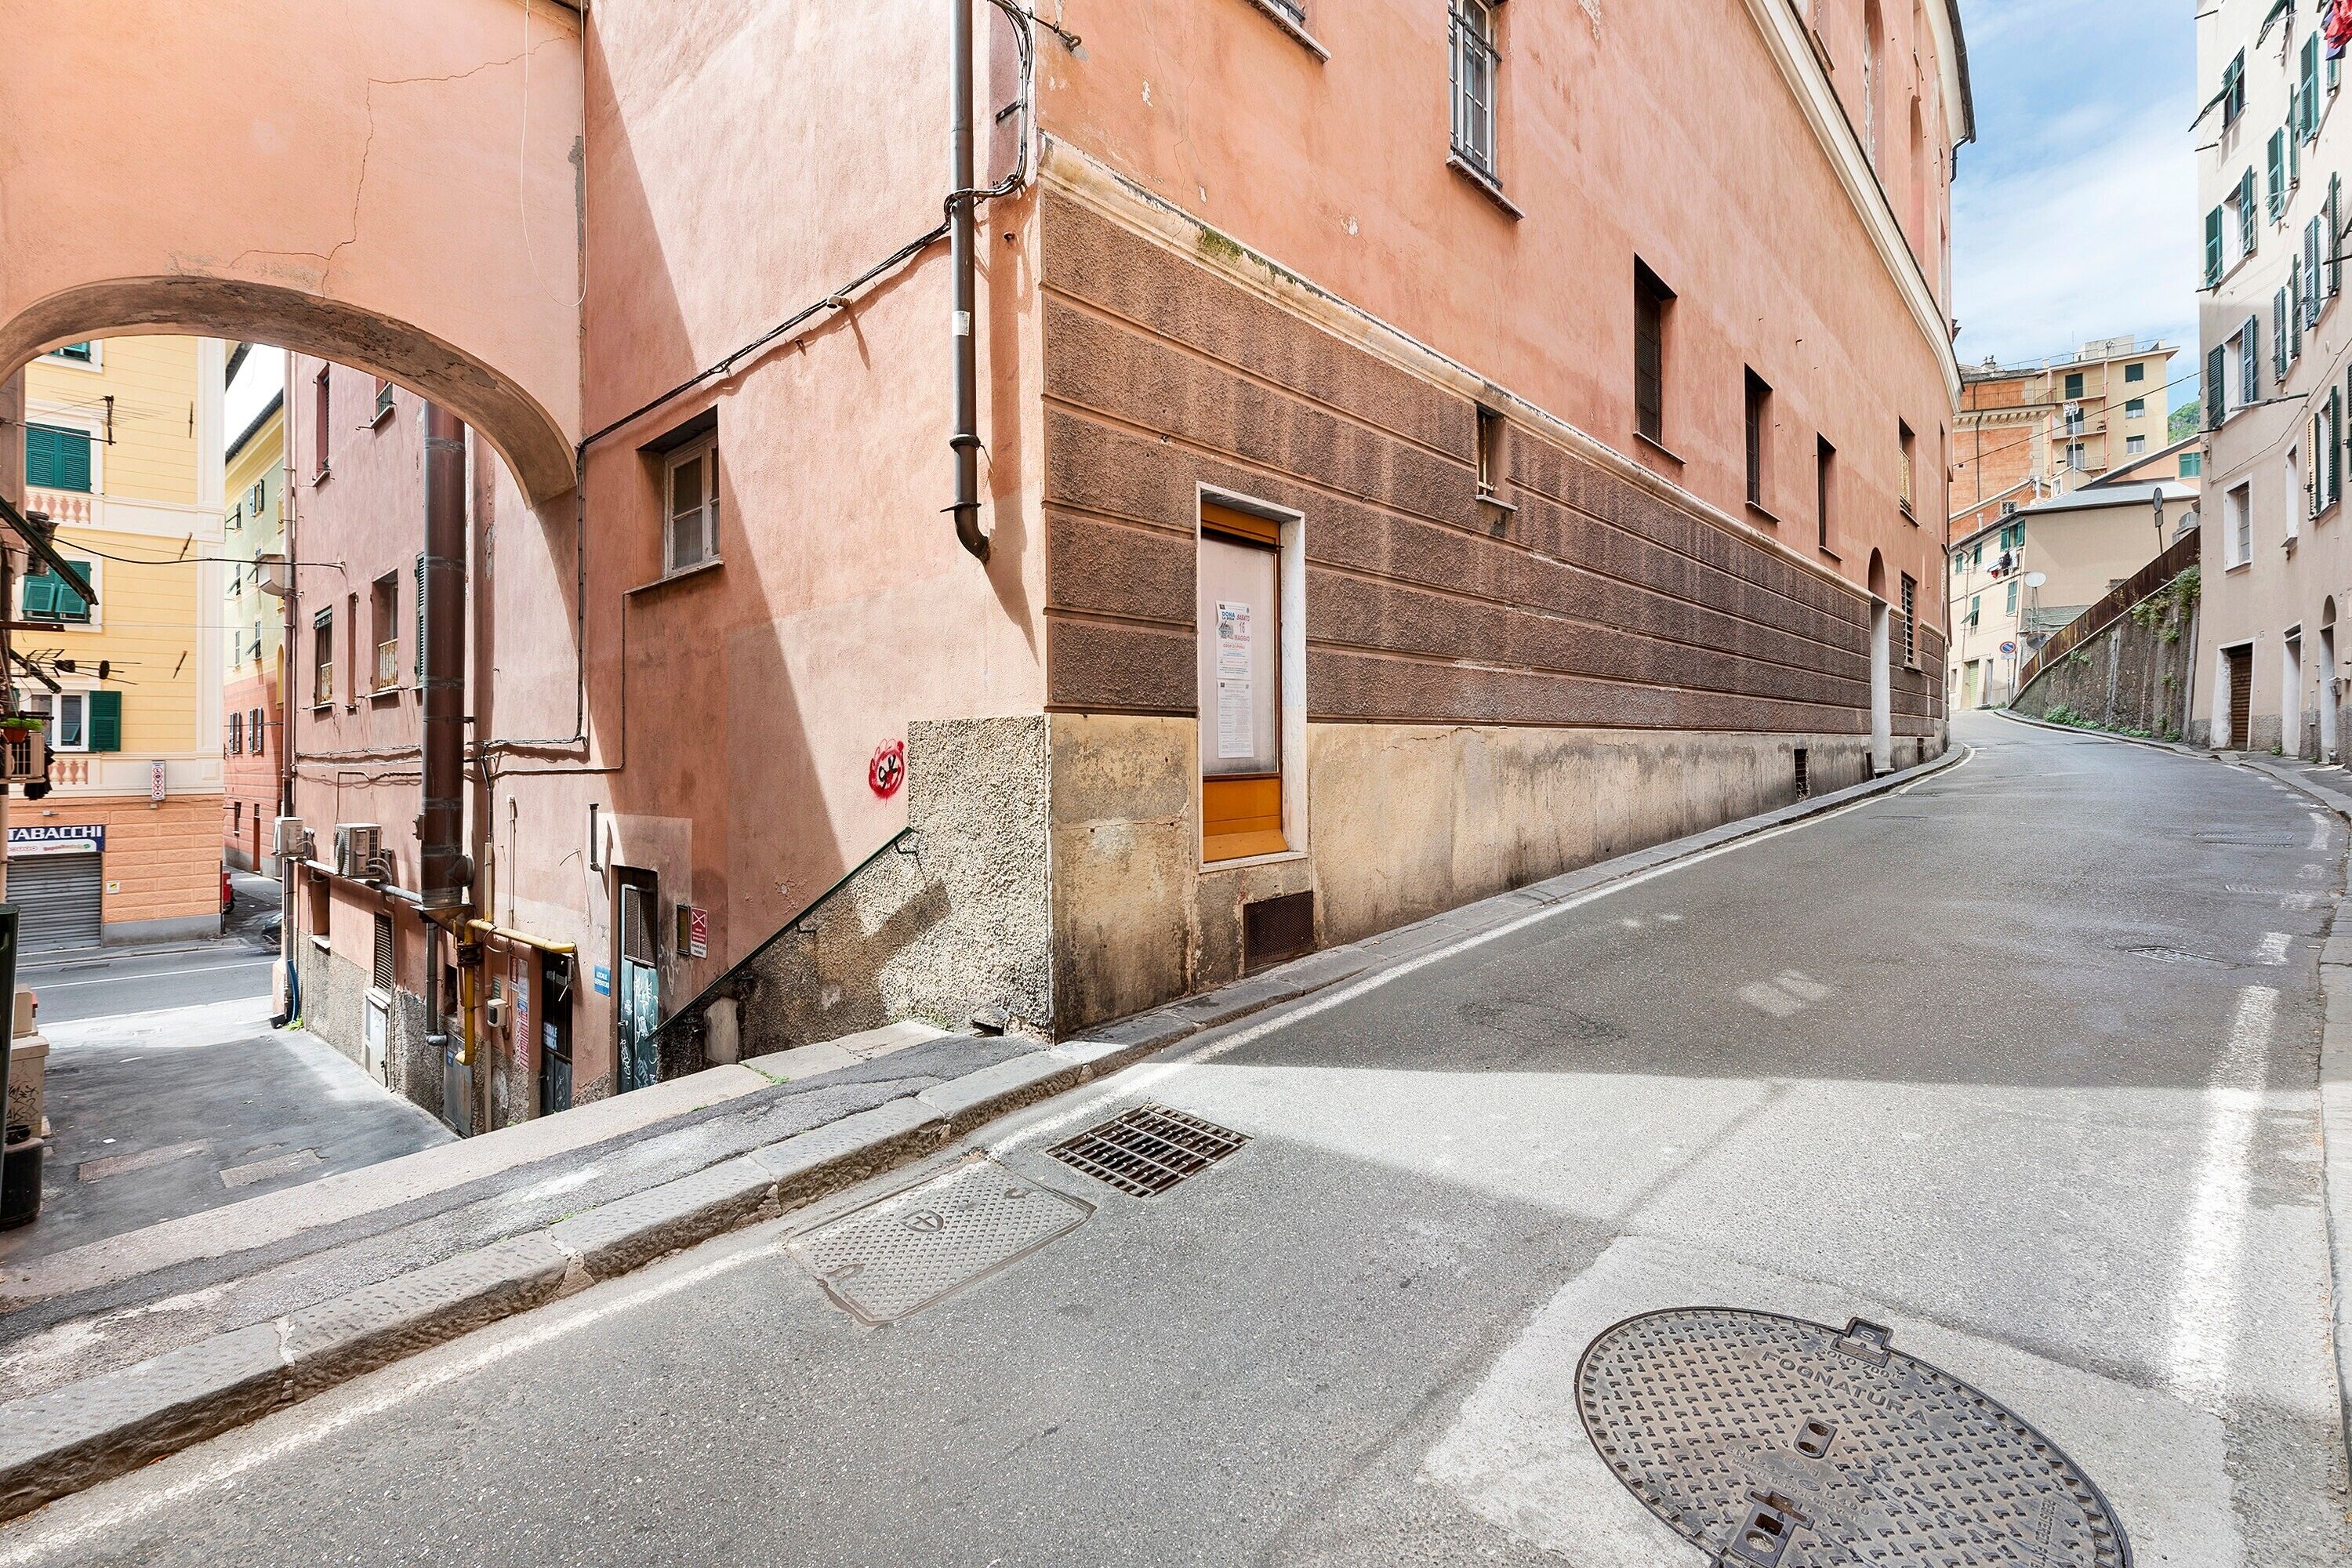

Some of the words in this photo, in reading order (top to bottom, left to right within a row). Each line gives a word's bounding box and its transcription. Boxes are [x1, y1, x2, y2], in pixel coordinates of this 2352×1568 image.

[1239, 621, 1245, 633] 16
[1234, 633, 1250, 642] MAGGIO
[8, 826, 102, 840] TABACCHI
[596, 971, 608, 981] LOCALE
[1817, 1345, 1857, 1367] SOLO
[1762, 1351, 1928, 1425] FOGNATURA
